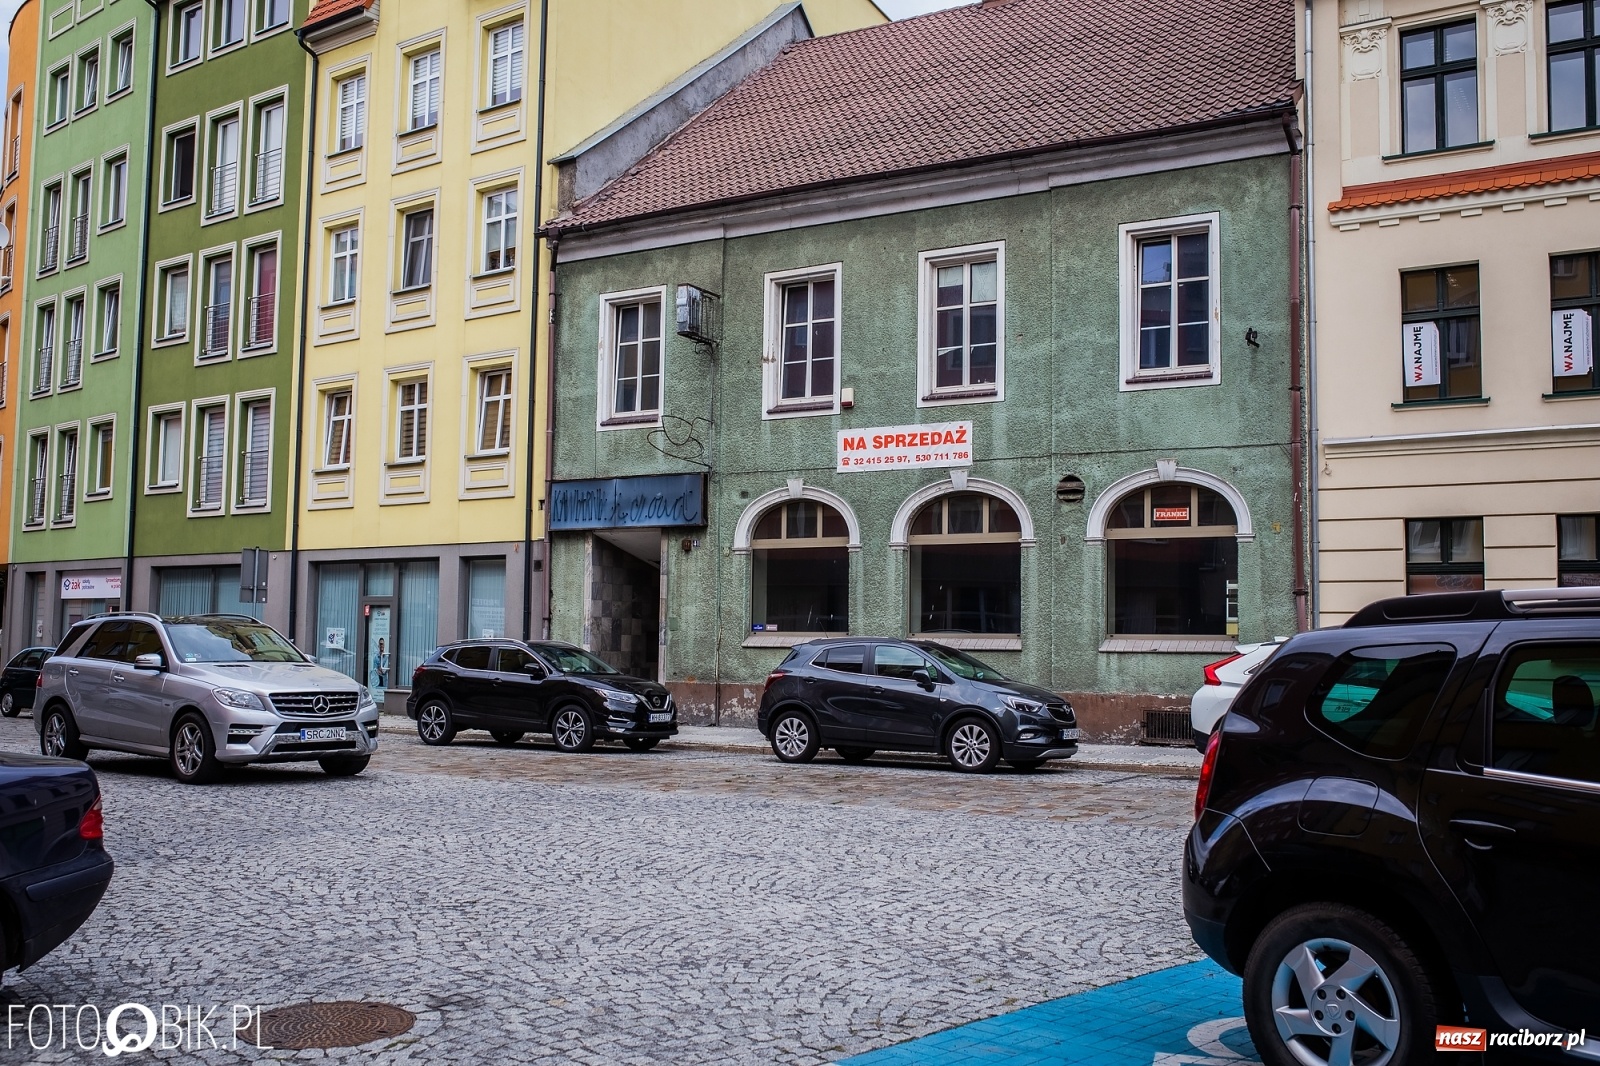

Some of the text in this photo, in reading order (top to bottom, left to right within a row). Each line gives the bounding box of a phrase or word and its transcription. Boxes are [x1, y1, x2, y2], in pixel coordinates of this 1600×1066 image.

[1563, 313, 1574, 372] WYNAJMĘ
[1413, 326, 1424, 382] WYNAJMĘ
[843, 426, 967, 451] NA SPRZEDAŻ
[866, 457, 882, 465] 415
[884, 456, 895, 464] 25
[897, 455, 911, 464] 97,
[915, 454, 931, 462] 530
[953, 451, 969, 459] 786
[71, 579, 81, 590] żak
[306, 730, 324, 739] SRC
